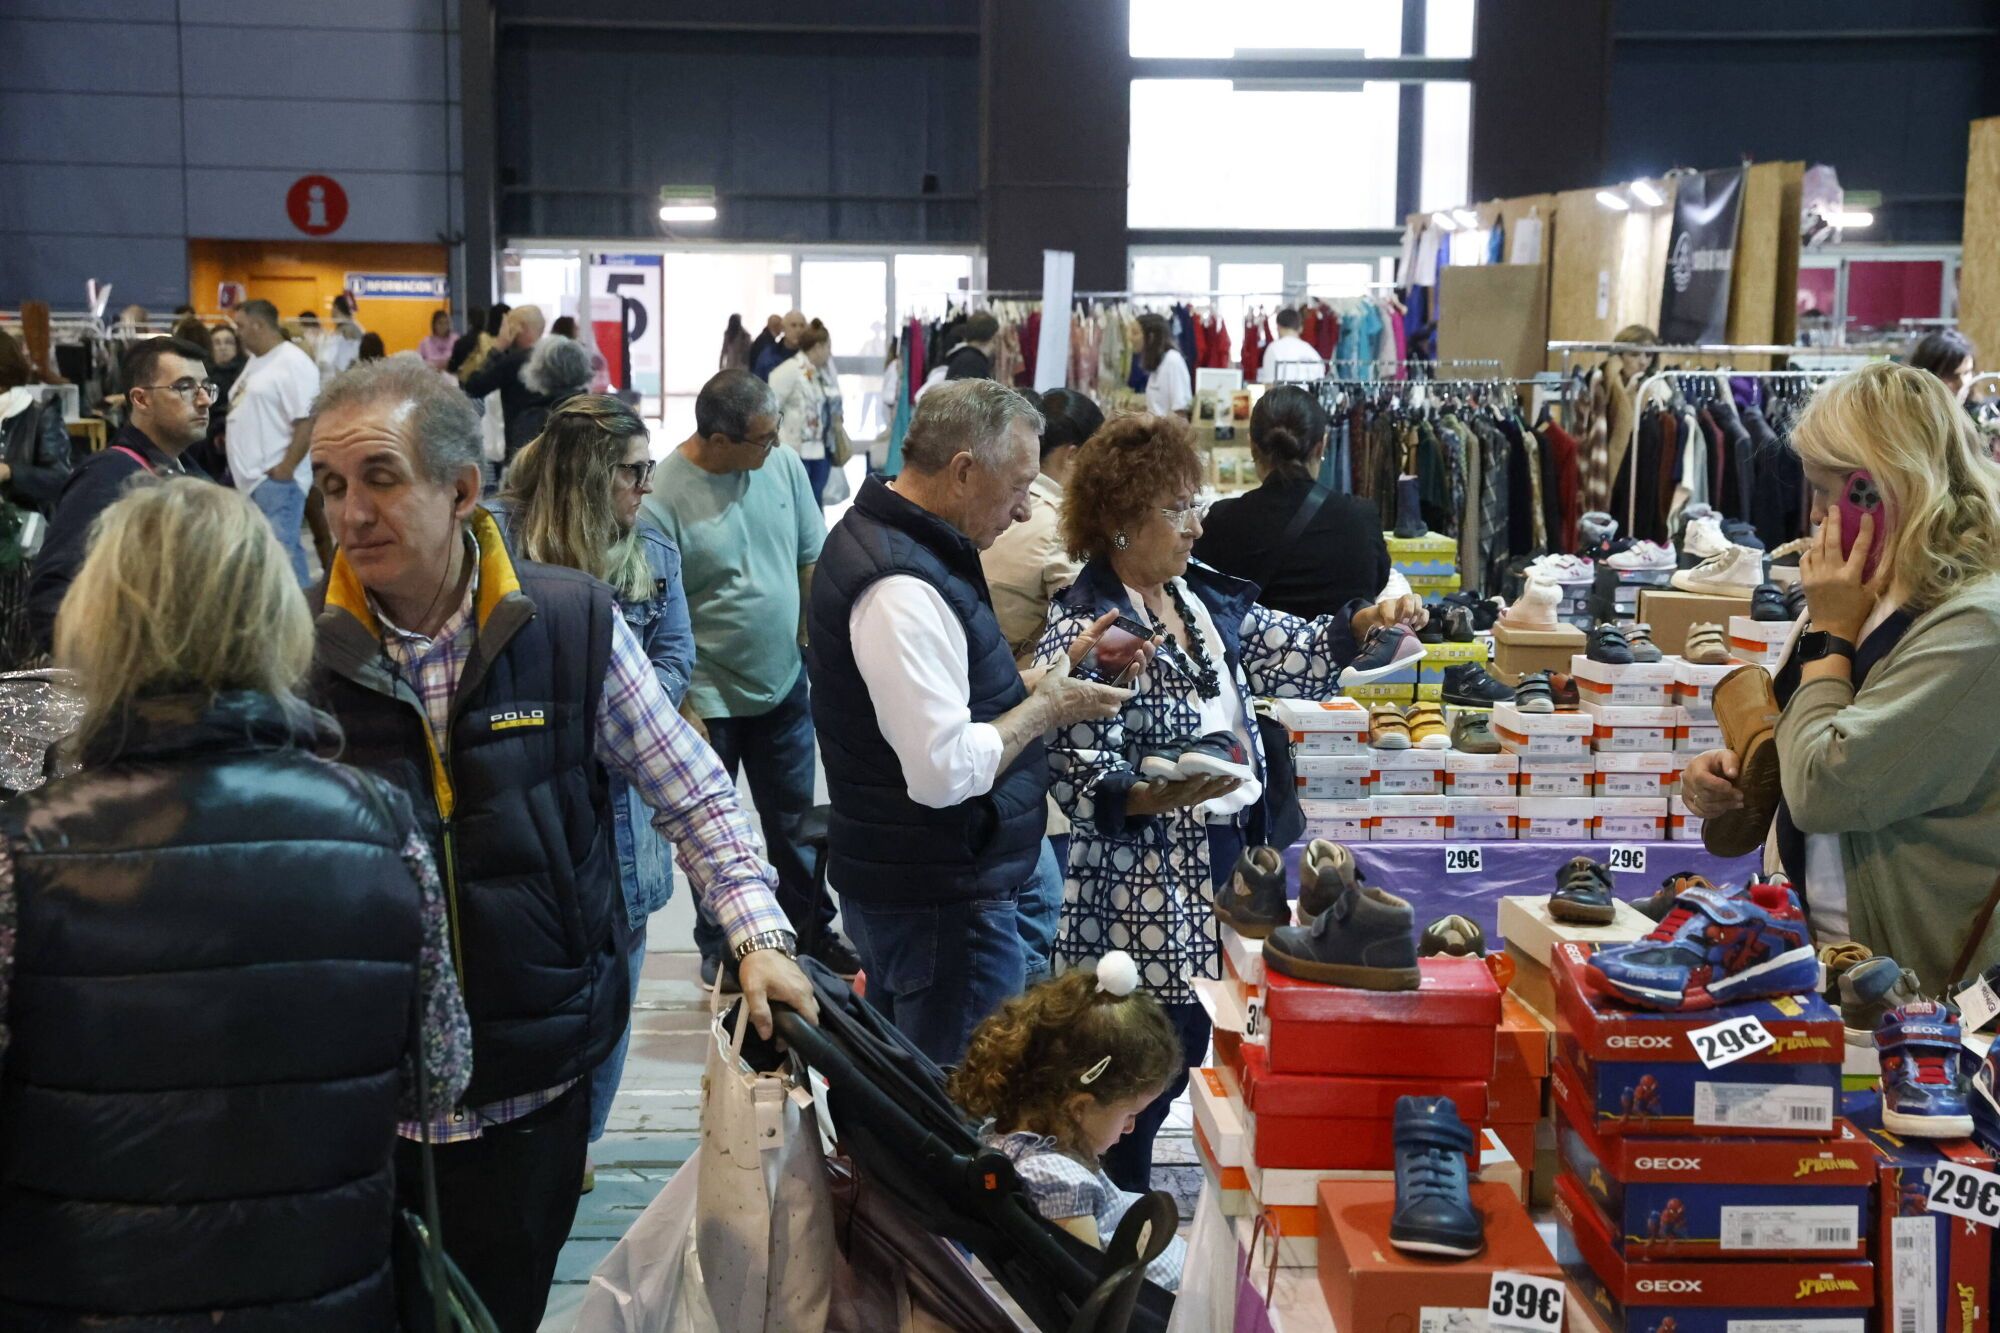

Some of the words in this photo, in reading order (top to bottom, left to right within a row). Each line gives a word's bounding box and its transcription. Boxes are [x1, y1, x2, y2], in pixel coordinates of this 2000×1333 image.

[490, 710, 544, 722] POLO
[1447, 850, 1480, 869] 29€
[1611, 848, 1644, 869] 29€
[1901, 1025, 1943, 1035] GEOX
[1606, 1035, 1672, 1048] GEOX
[1635, 1157, 1701, 1170] GEOX
[1932, 1169, 2000, 1217] 29€
[1636, 1280, 1702, 1293] GEOX
[1492, 1281, 1561, 1324] 39€
